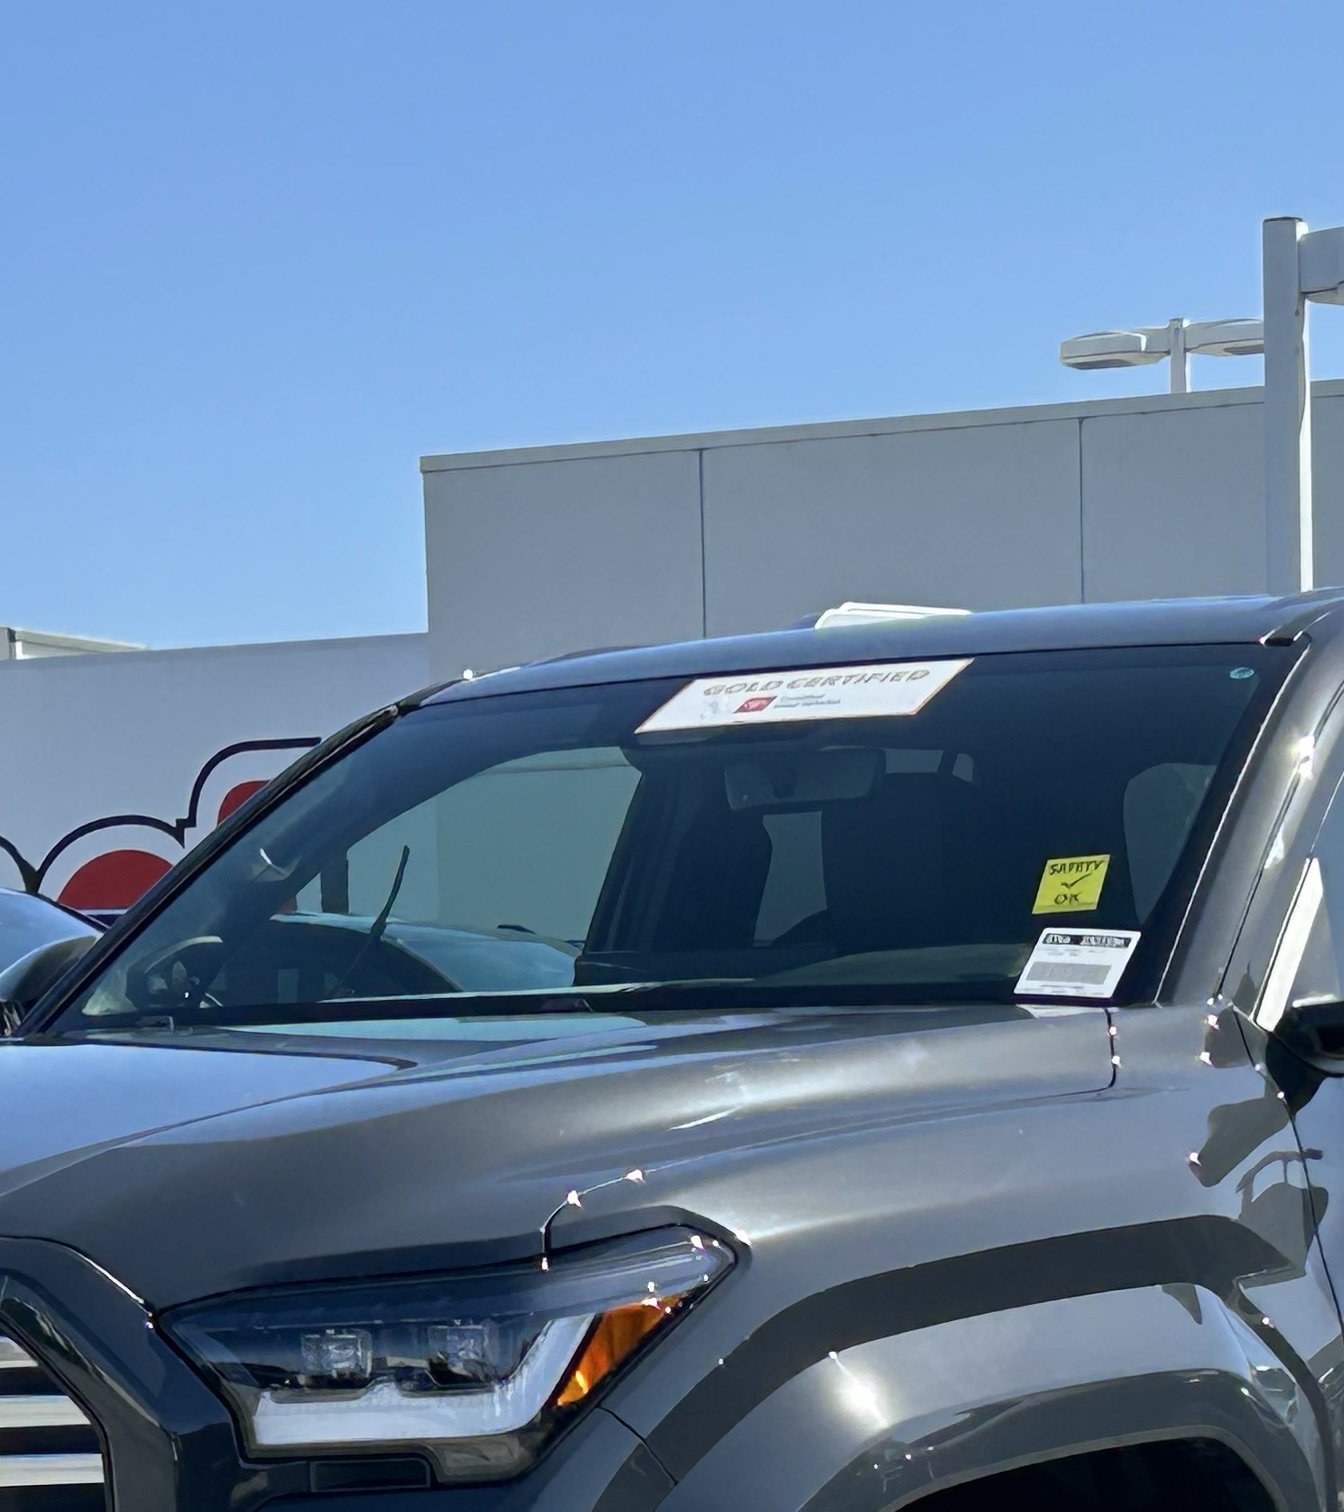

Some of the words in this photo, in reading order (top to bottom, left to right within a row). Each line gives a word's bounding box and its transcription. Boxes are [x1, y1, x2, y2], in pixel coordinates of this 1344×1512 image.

[703, 680, 784, 697] GOLD
[786, 669, 931, 690] CERTIFIED
[1053, 892, 1082, 905] OK
